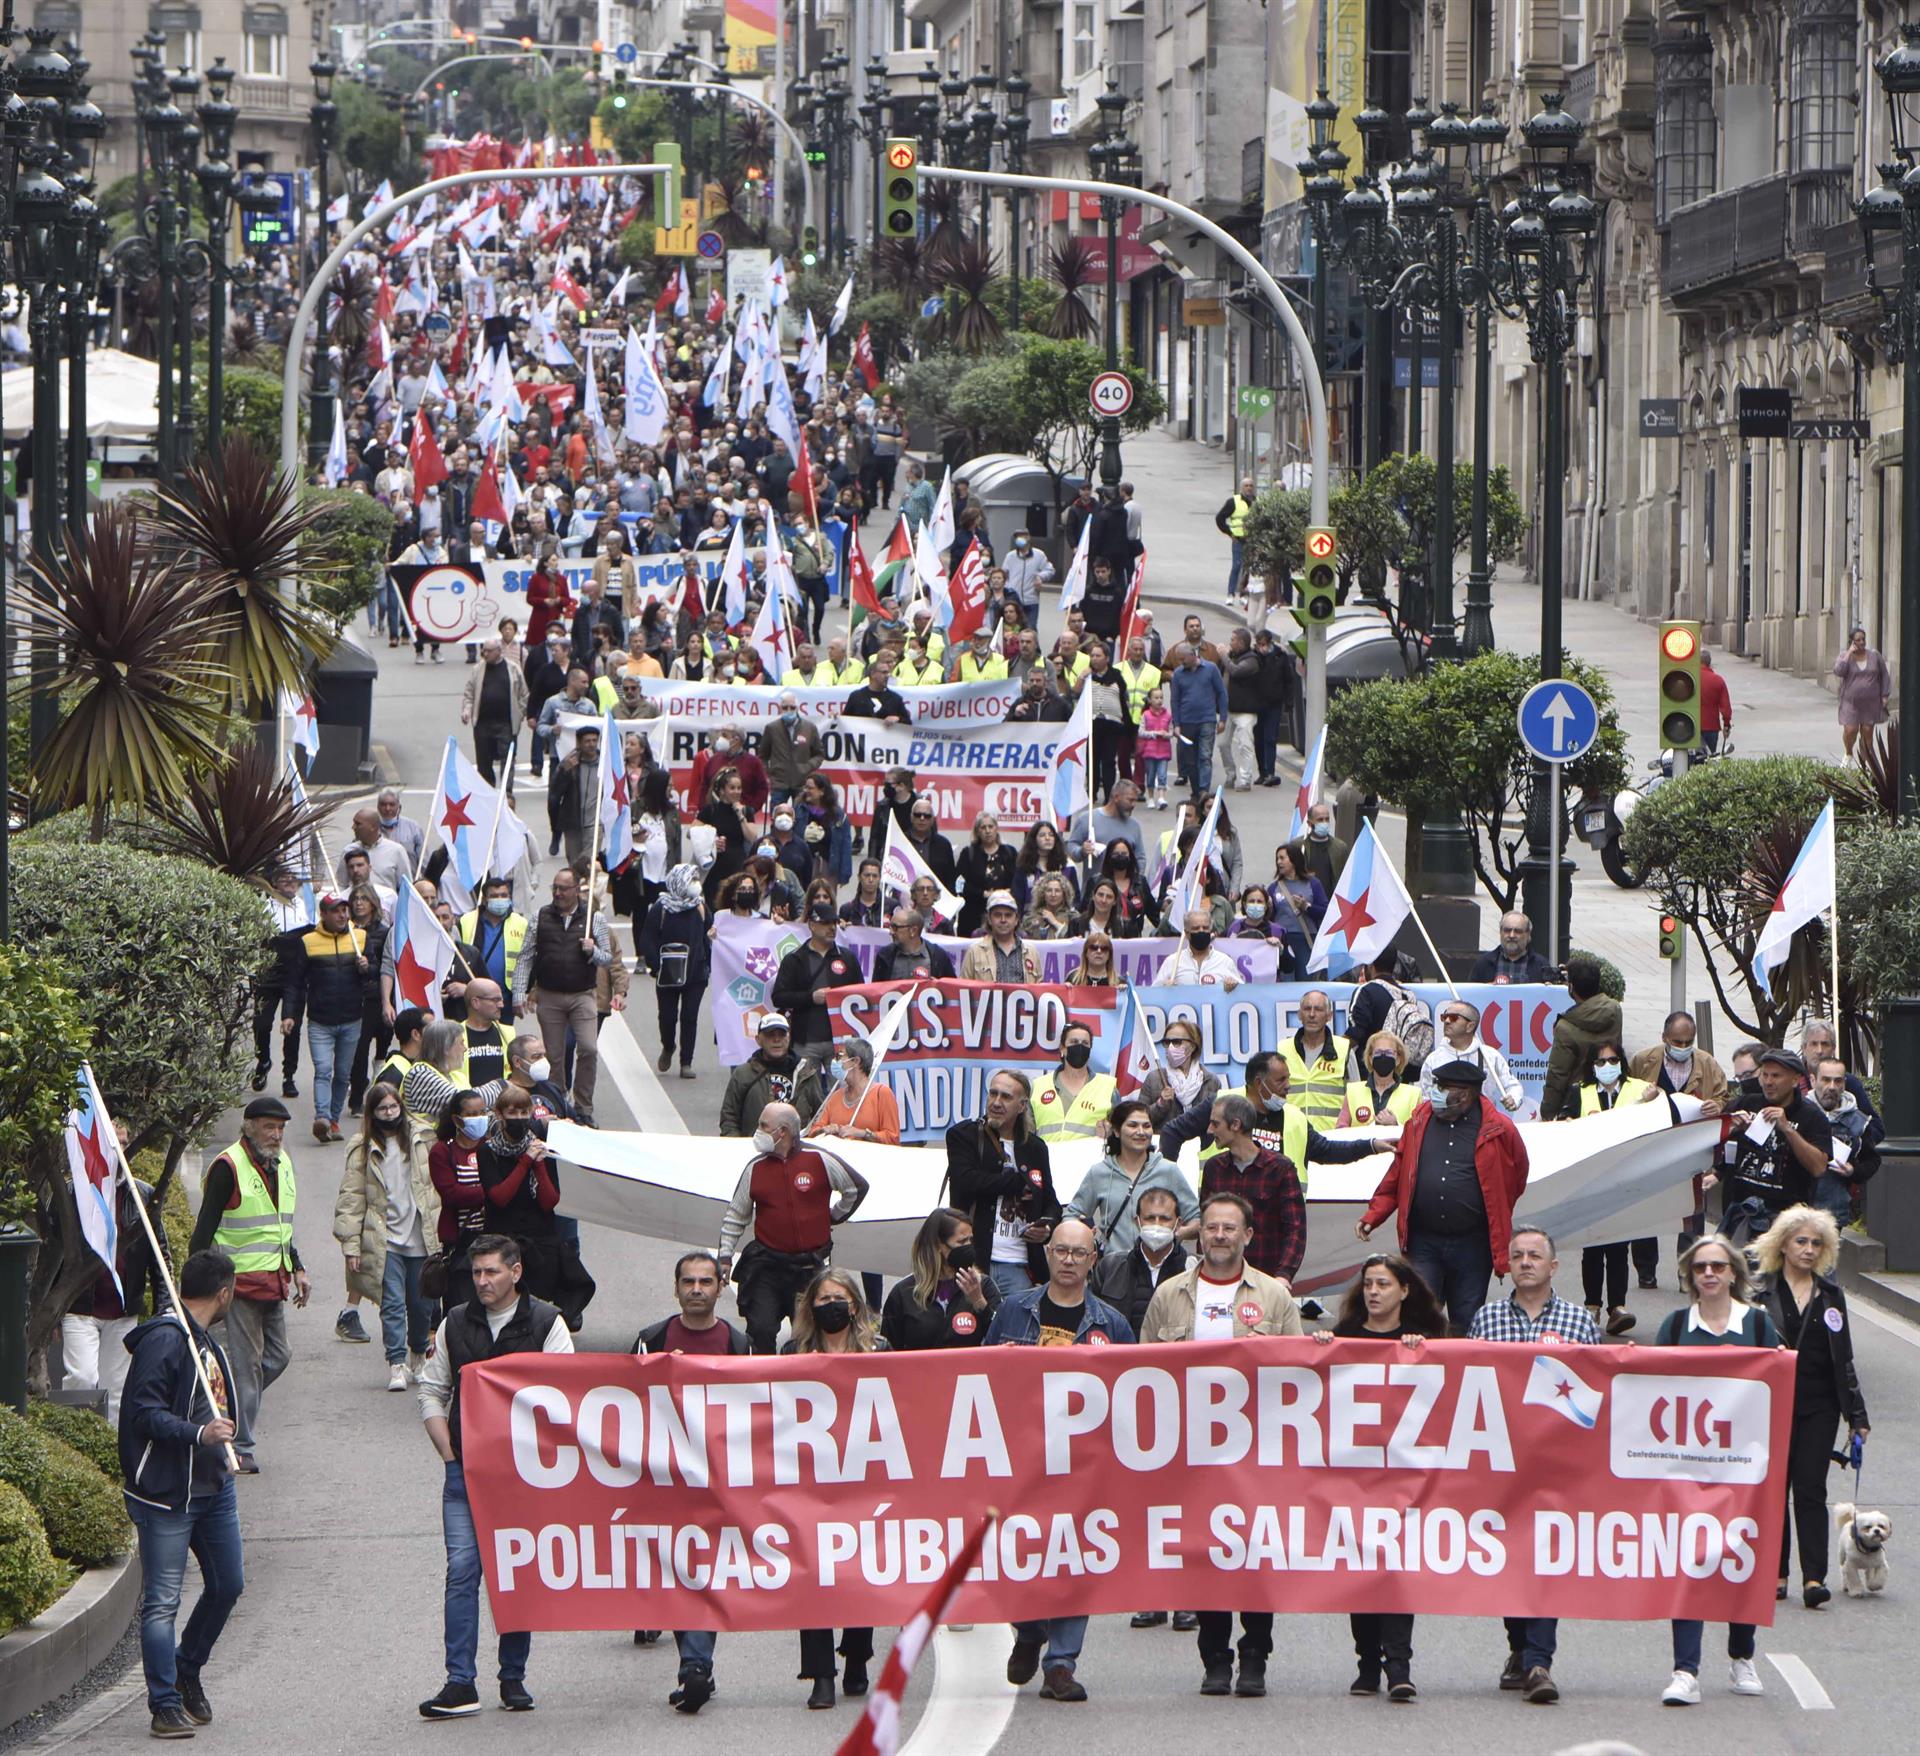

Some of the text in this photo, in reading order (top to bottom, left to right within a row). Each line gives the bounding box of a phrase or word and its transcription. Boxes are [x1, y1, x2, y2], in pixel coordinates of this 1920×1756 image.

[1098, 386, 1125, 402] 40
[1741, 408, 1788, 418] SEPHORA
[1792, 424, 1861, 439] ZARA
[669, 696, 760, 716] DEFENSA
[767, 700, 809, 717] DS
[918, 695, 1011, 720] PÚBLICOS
[871, 745, 899, 765] en
[907, 741, 1059, 769] BARRERAS
[996, 787, 1042, 814] CIG
[959, 988, 1067, 1051] VIGO
[510, 1363, 1517, 1489] CONTRA A POBREZA
[1649, 1396, 1733, 1449] CIG
[1626, 1449, 1752, 1465] Confederación Intersindical Galega
[493, 1502, 1759, 1593] POLÍTICAS PÚBLICAS E SALARIOS DIGNOS
